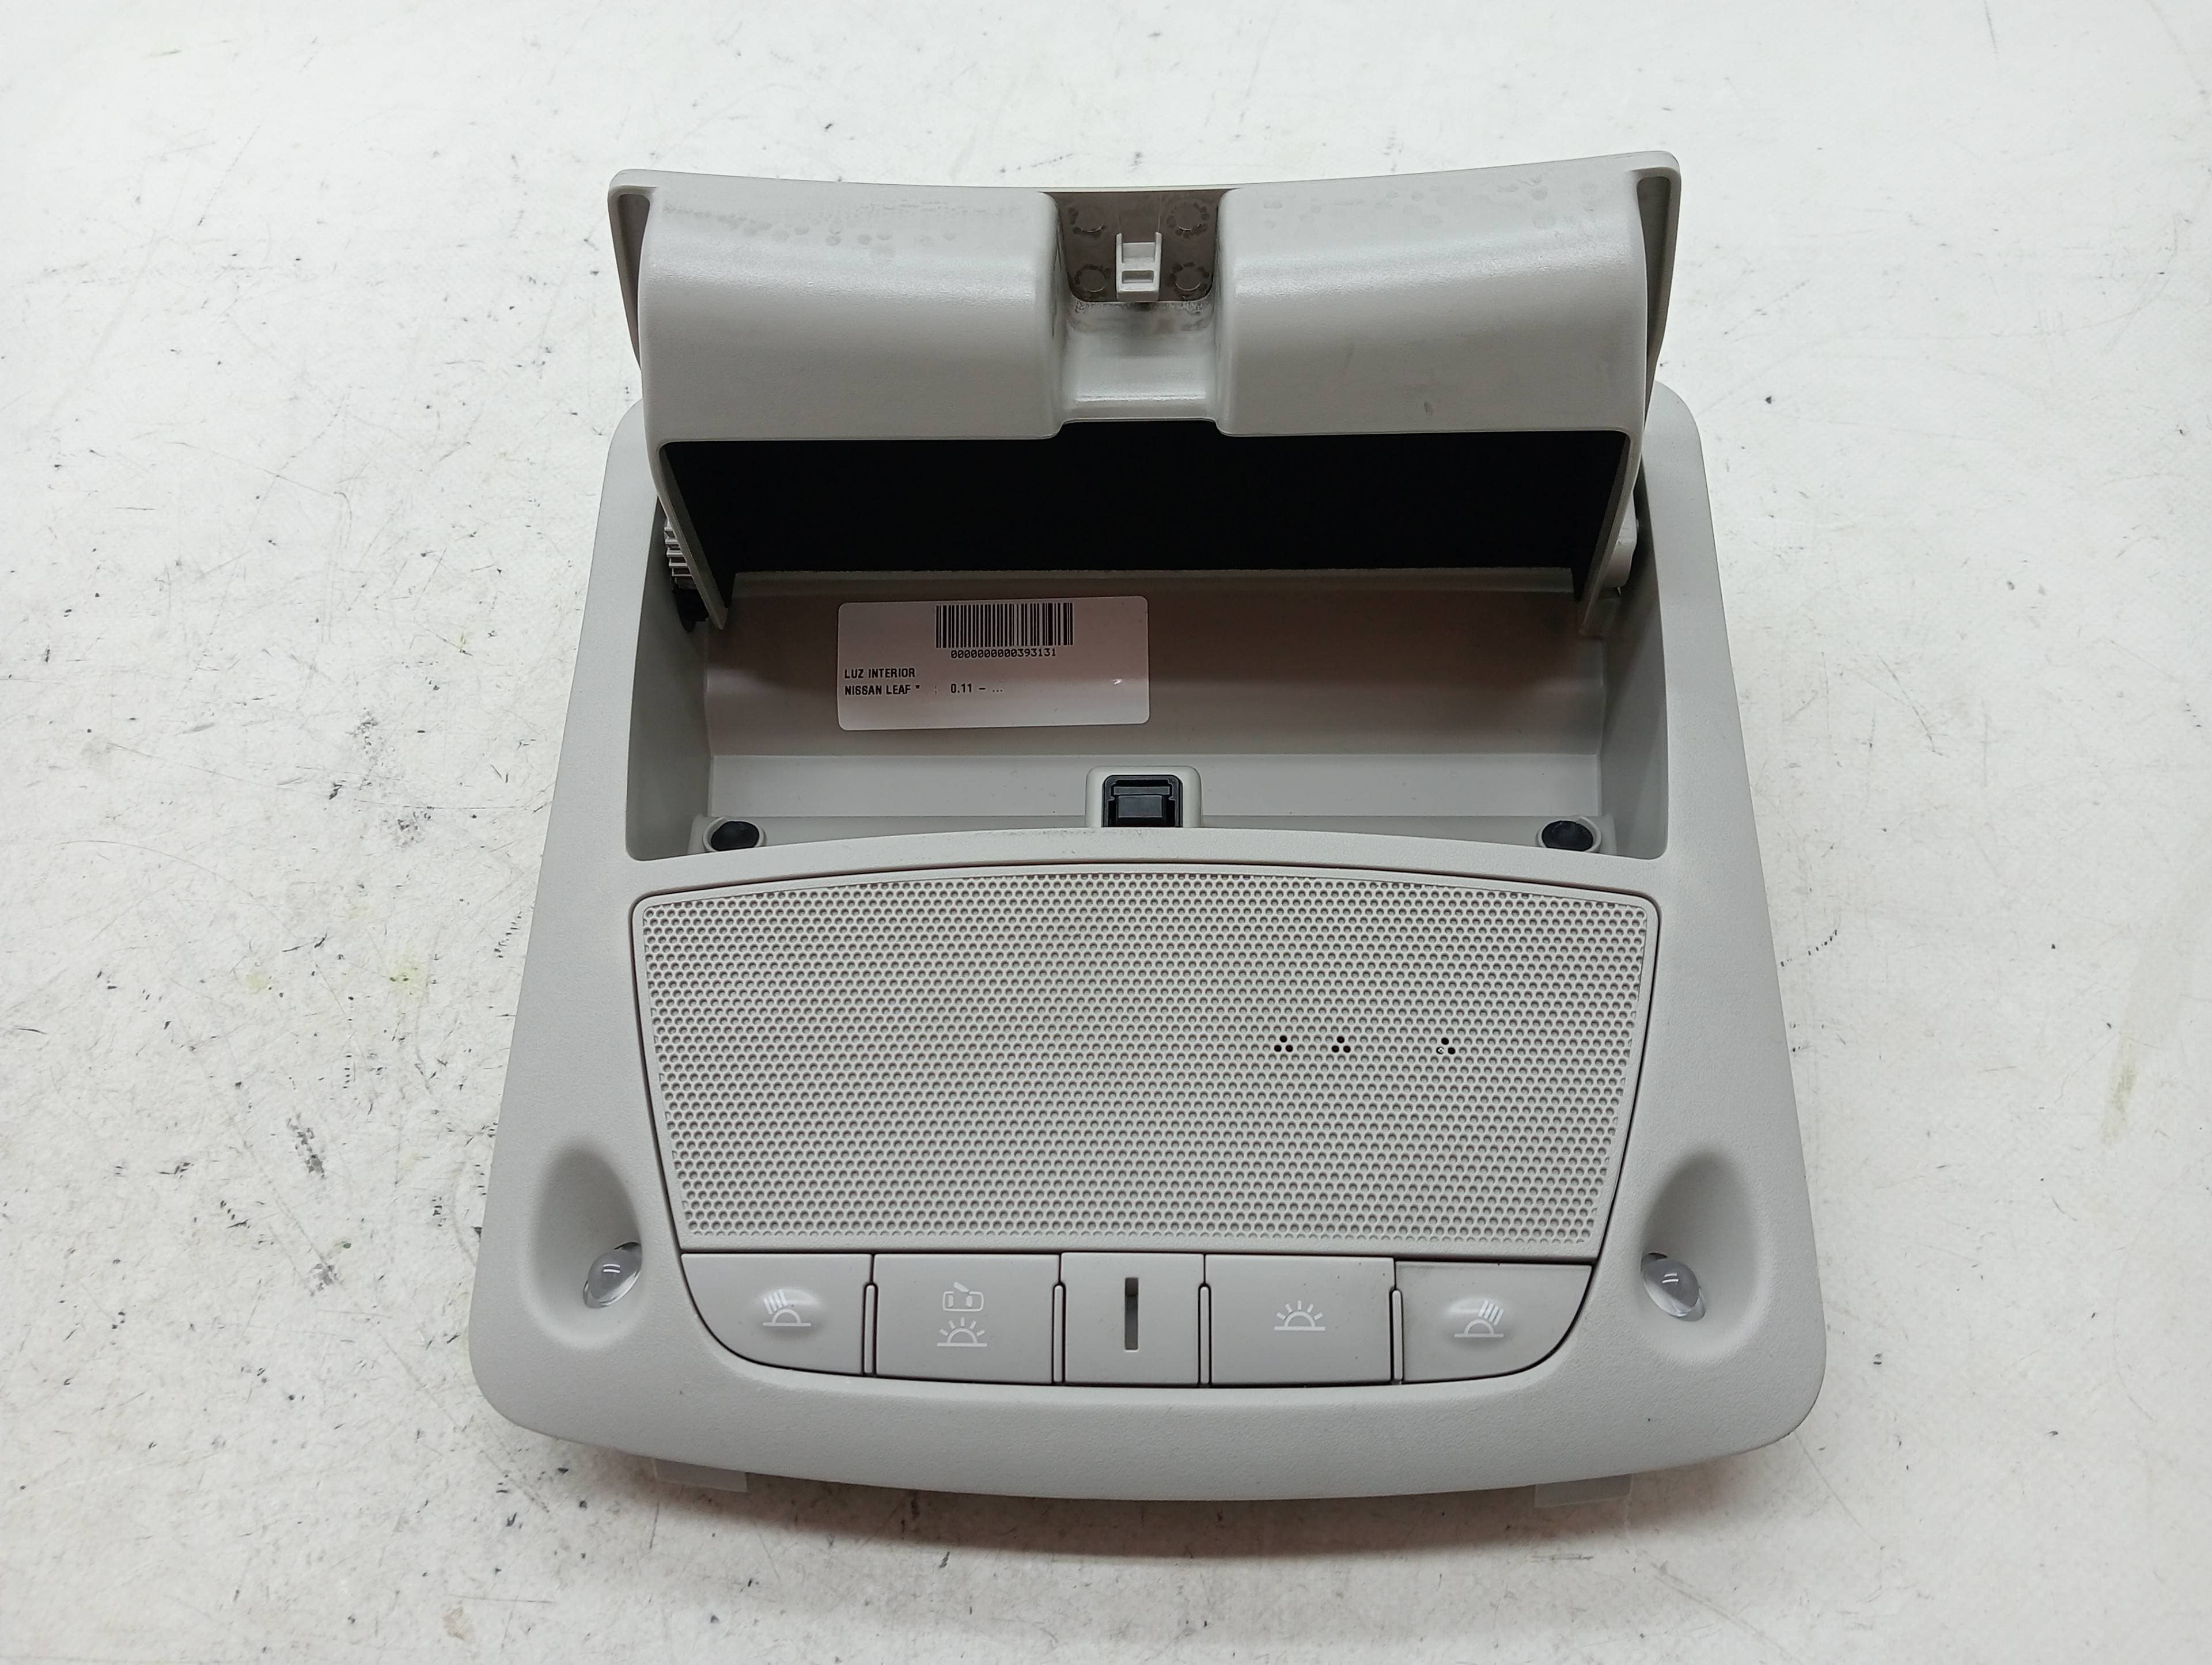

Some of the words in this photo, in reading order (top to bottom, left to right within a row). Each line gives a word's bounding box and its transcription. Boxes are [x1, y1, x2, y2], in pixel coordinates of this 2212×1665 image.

[950, 648, 1056, 658] 0000000000393131
[844, 669, 864, 678] LUZ
[868, 667, 915, 678] INTERIOR
[844, 685, 882, 695] NISSAN
[886, 684, 911, 695] LEAF
[950, 683, 972, 693] 0.11
